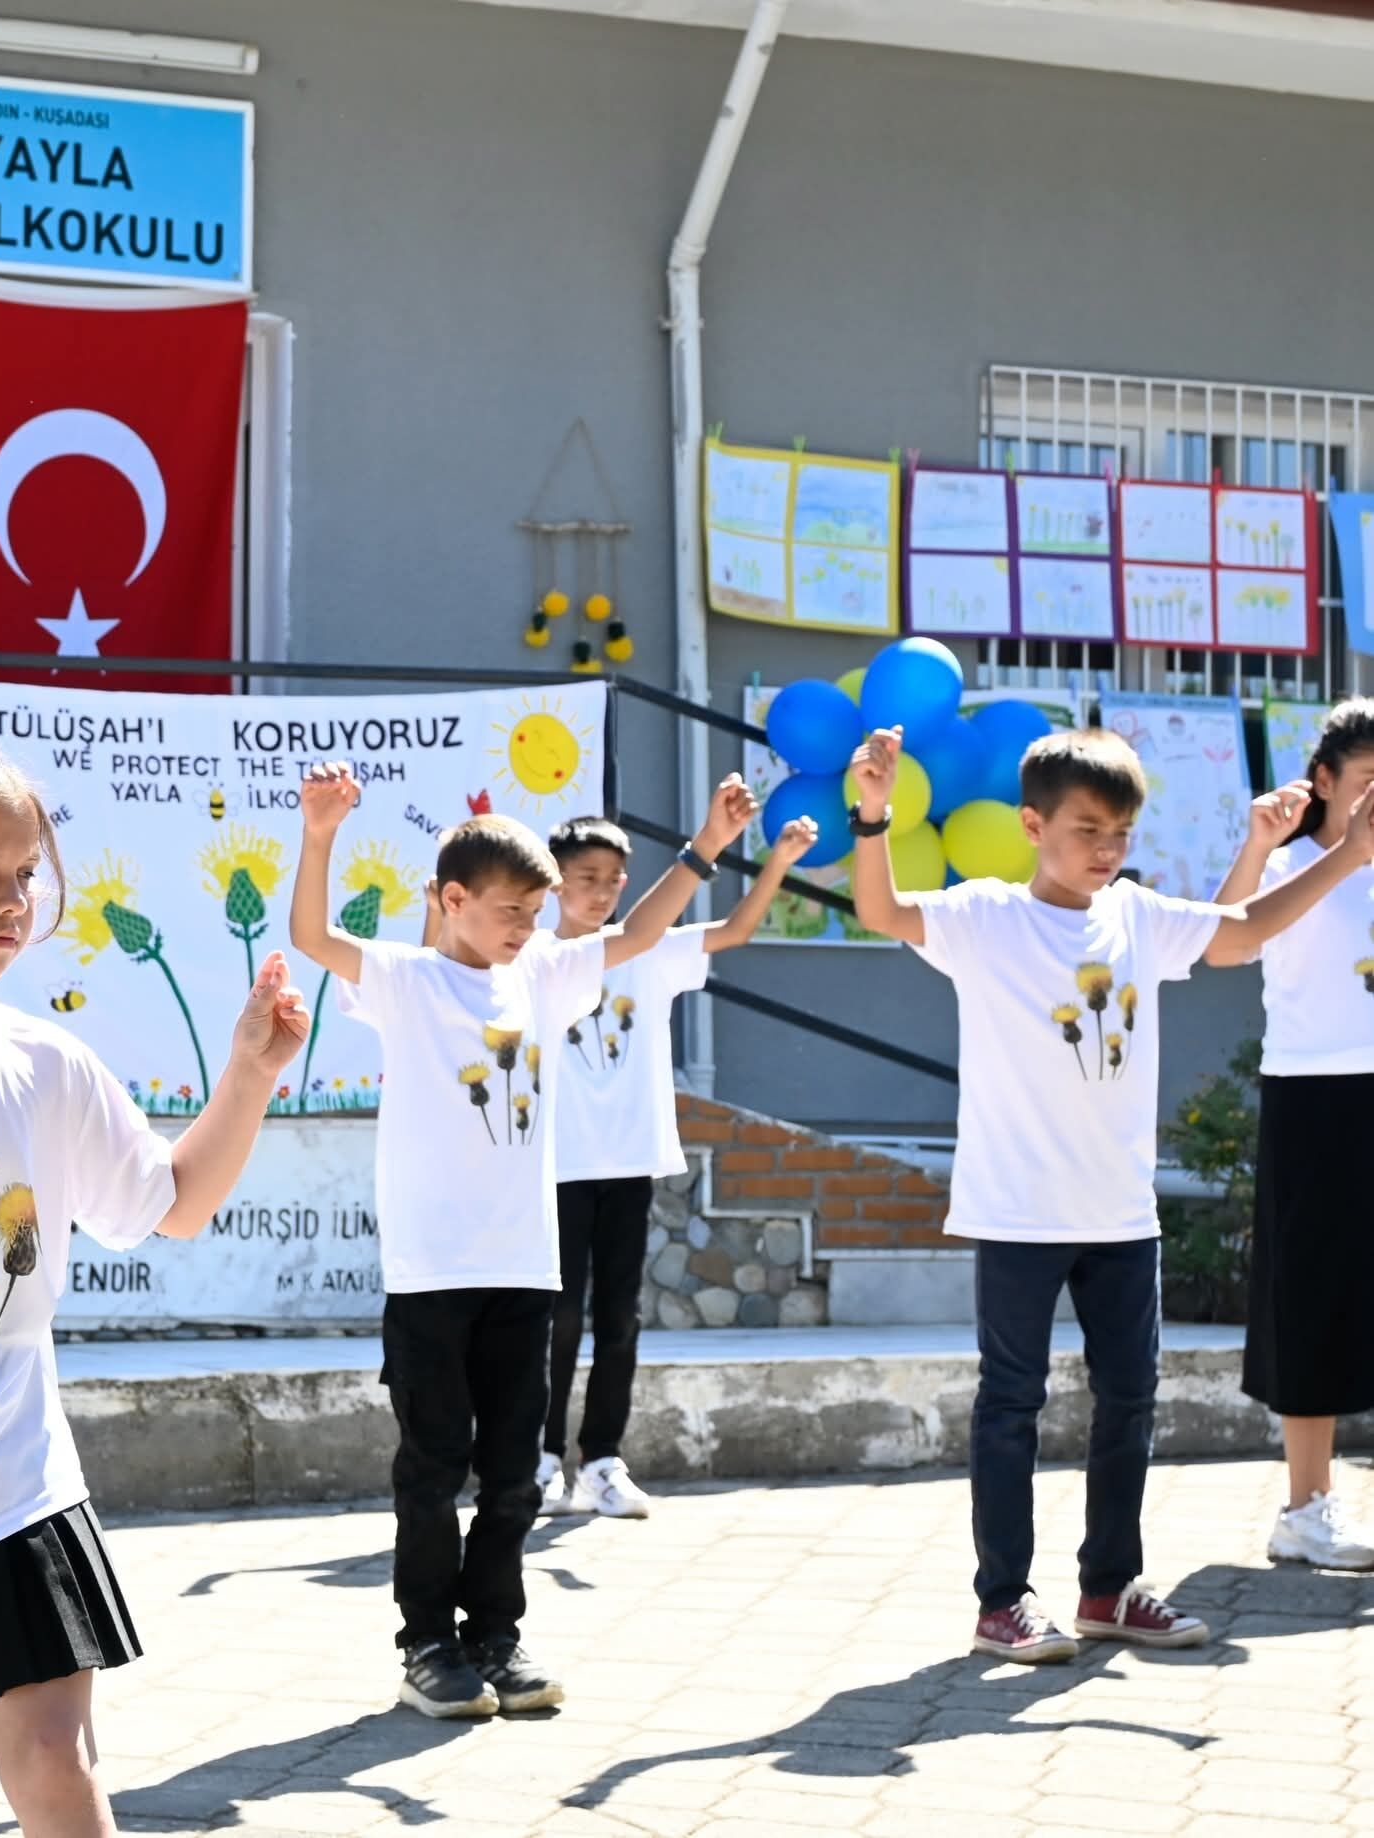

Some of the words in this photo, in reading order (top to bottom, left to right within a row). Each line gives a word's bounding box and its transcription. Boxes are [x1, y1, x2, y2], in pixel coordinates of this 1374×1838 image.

[33, 106, 110, 129] KUŞADASI
[233, 716, 463, 752] KORUYORUZ
[53, 748, 93, 771] WE
[112, 754, 221, 777] PROTECT
[237, 756, 284, 778] THE
[295, 757, 406, 787] TŞAH
[111, 782, 182, 803] YAYLA
[248, 784, 362, 810] İLKO
[404, 804, 444, 841] SAV
[211, 1200, 320, 1245] MÜRŞİD
[72, 1256, 151, 1292] ENDİR
